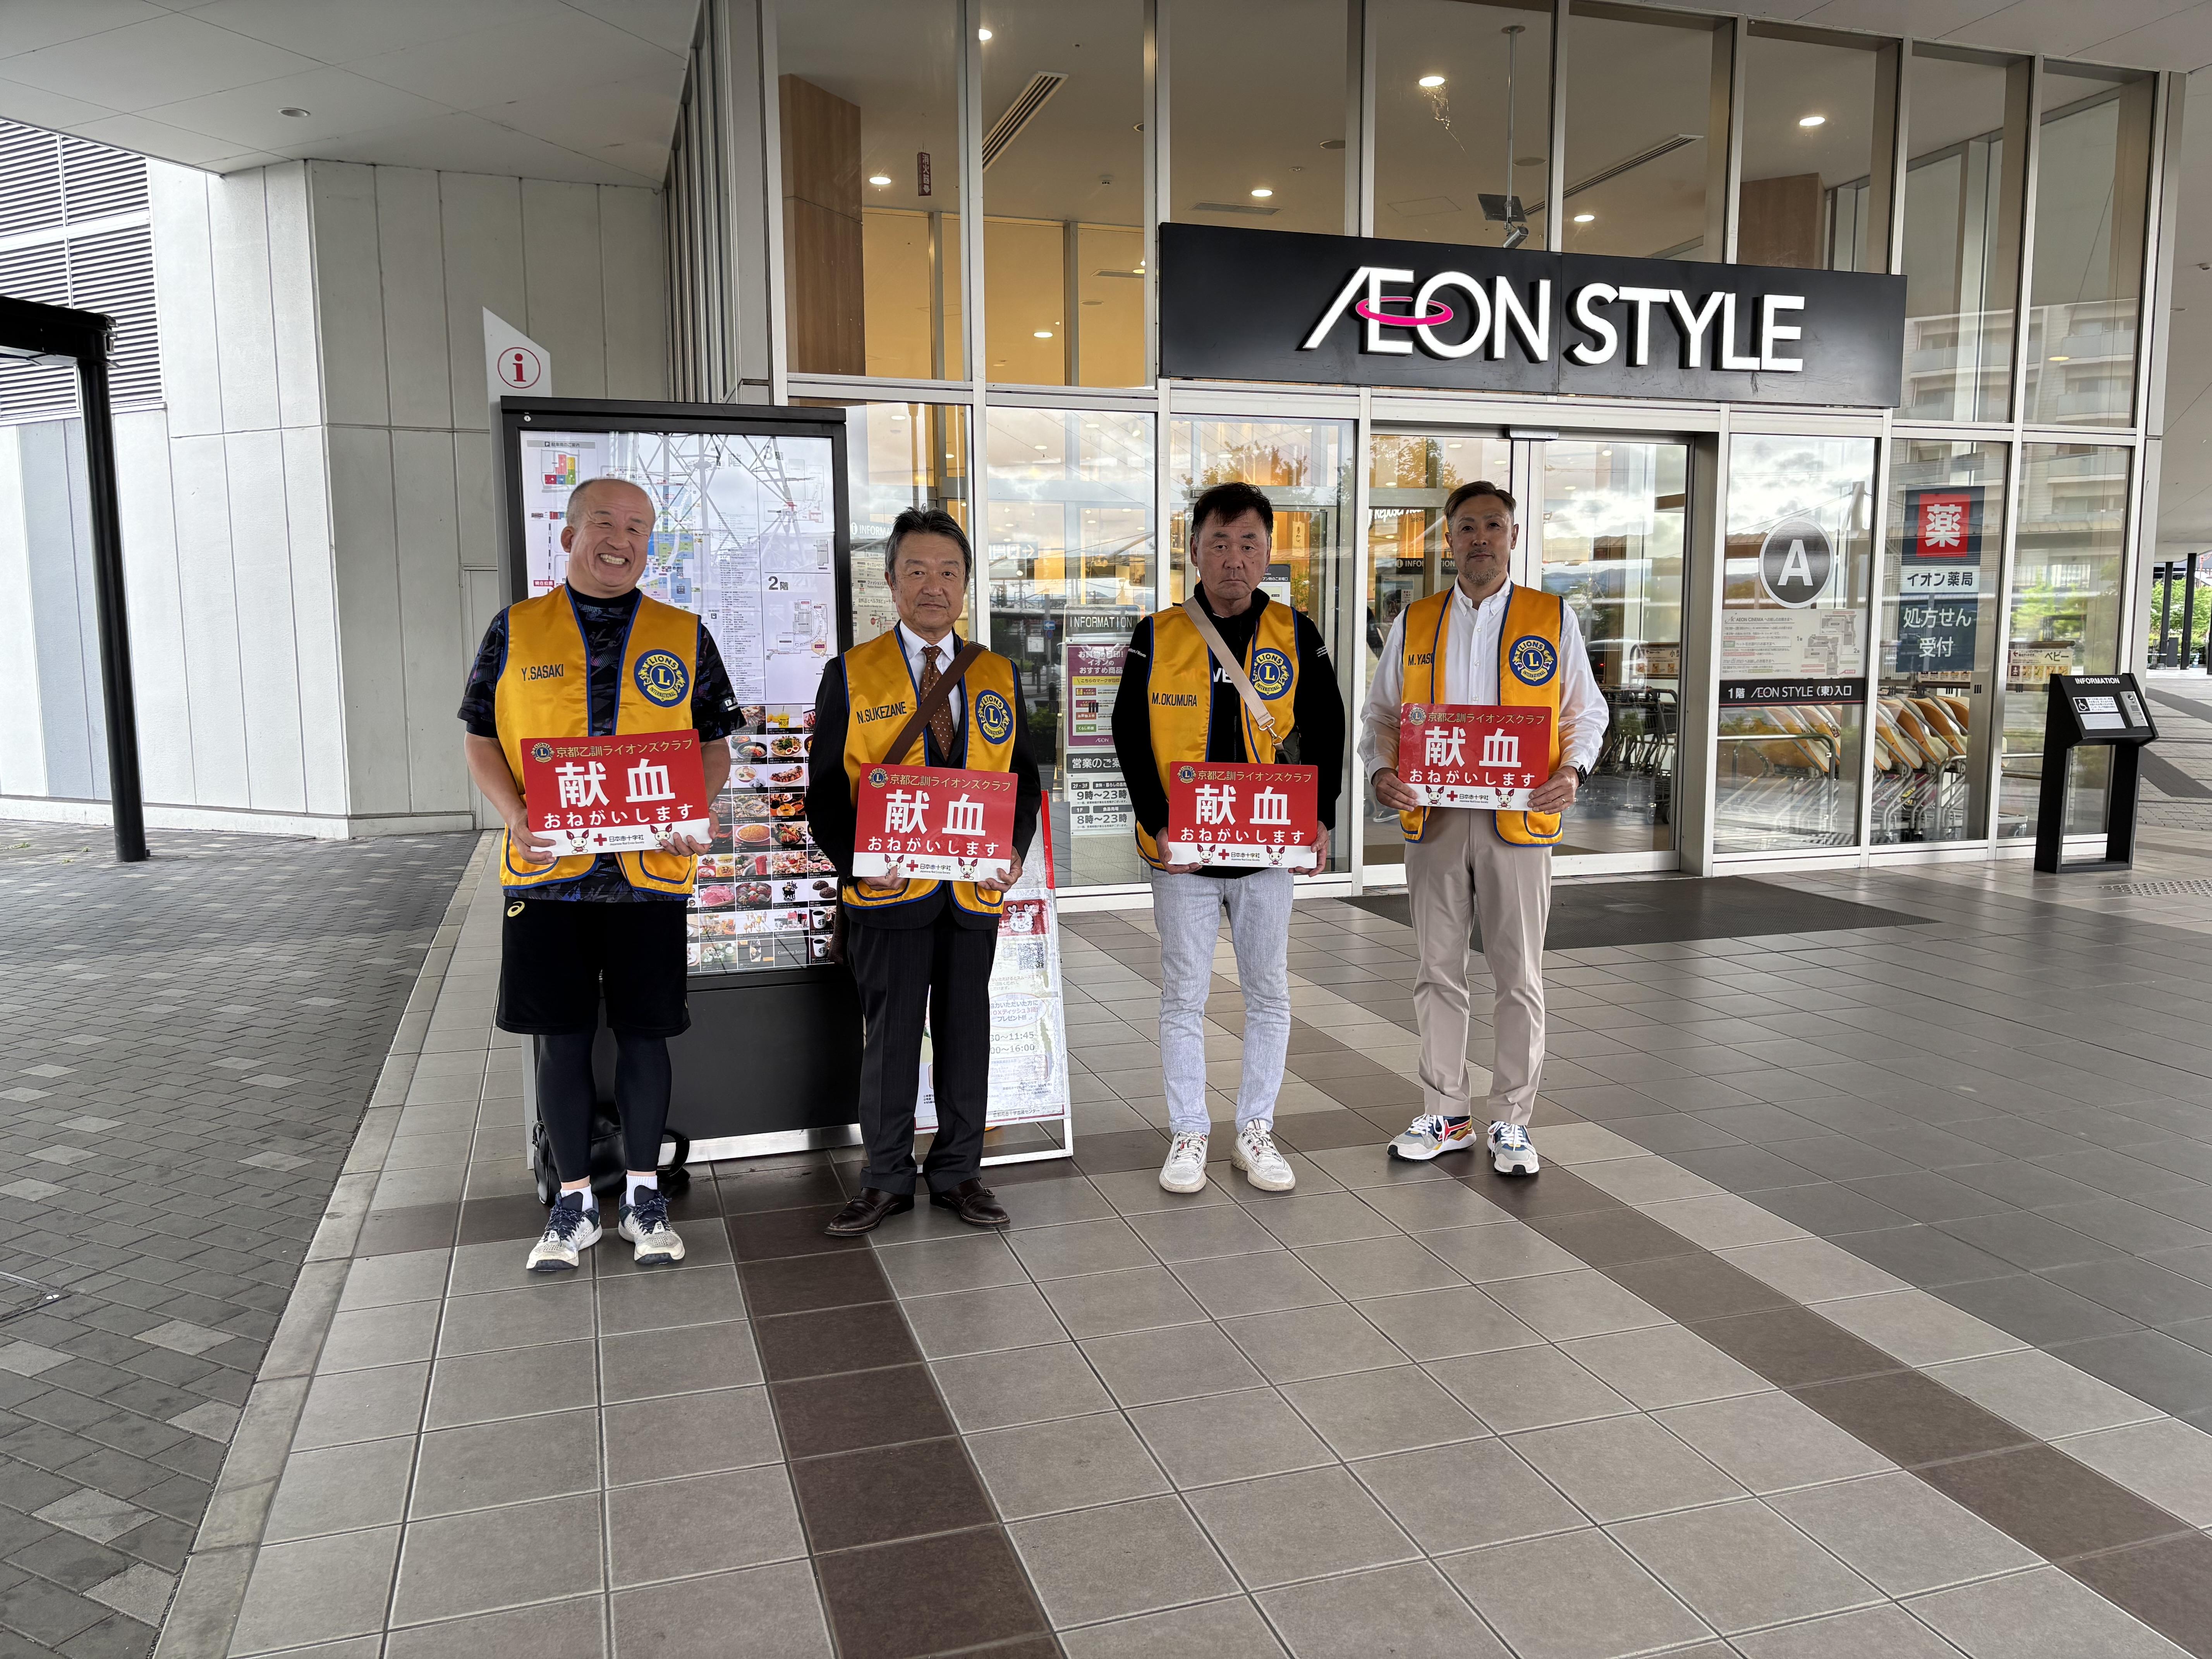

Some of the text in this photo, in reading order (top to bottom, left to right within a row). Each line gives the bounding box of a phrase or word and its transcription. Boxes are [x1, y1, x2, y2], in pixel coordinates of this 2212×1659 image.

[1572, 282, 1805, 372] STYLE
[860, 525, 891, 536] INFORMA
[1925, 504, 1961, 547] 薬
[1778, 539, 1813, 586] A
[768, 576, 789, 591] 2階
[1907, 572, 1973, 587] イオン薬局
[1070, 617, 1132, 628] INFORMATION
[1903, 608, 1972, 628] 処方せん
[1519, 641, 1544, 651] LIONS
[1919, 637, 1953, 658] 受付
[649, 656, 677, 668] LIONS
[1258, 654, 1282, 664] LIONS
[1527, 653, 1539, 666] L
[2045, 651, 2069, 662] ベビー
[521, 664, 563, 681] Y.SASAKI
[658, 668, 670, 686] L
[1264, 665, 1275, 681] L
[1152, 692, 1197, 707] M.OKUMURA
[1728, 688, 1745, 699] 1階
[1782, 686, 1813, 697] STYLE
[983, 696, 1002, 708] LIONS
[856, 701, 907, 724] N.SUKEZANE
[989, 708, 998, 724] L
[1428, 712, 1546, 725] 京都乙訓ライオンズクラブ
[556, 738, 693, 758] 京都乙訓ライオンズクラブ
[1425, 726, 1522, 768] 献血
[555, 758, 675, 808] 献血
[890, 774, 1012, 792] 京都乙訓ライオンズクラブ
[1197, 770, 1312, 783] 京都乙訓ライオンズクラブ
[1409, 769, 1535, 787] おねがいします
[885, 789, 986, 836] 献血
[1195, 784, 1291, 825] 献血
[544, 804, 693, 829] おねがいします
[1180, 827, 1304, 844] おねがいします
[867, 836, 999, 857] おねがいします
